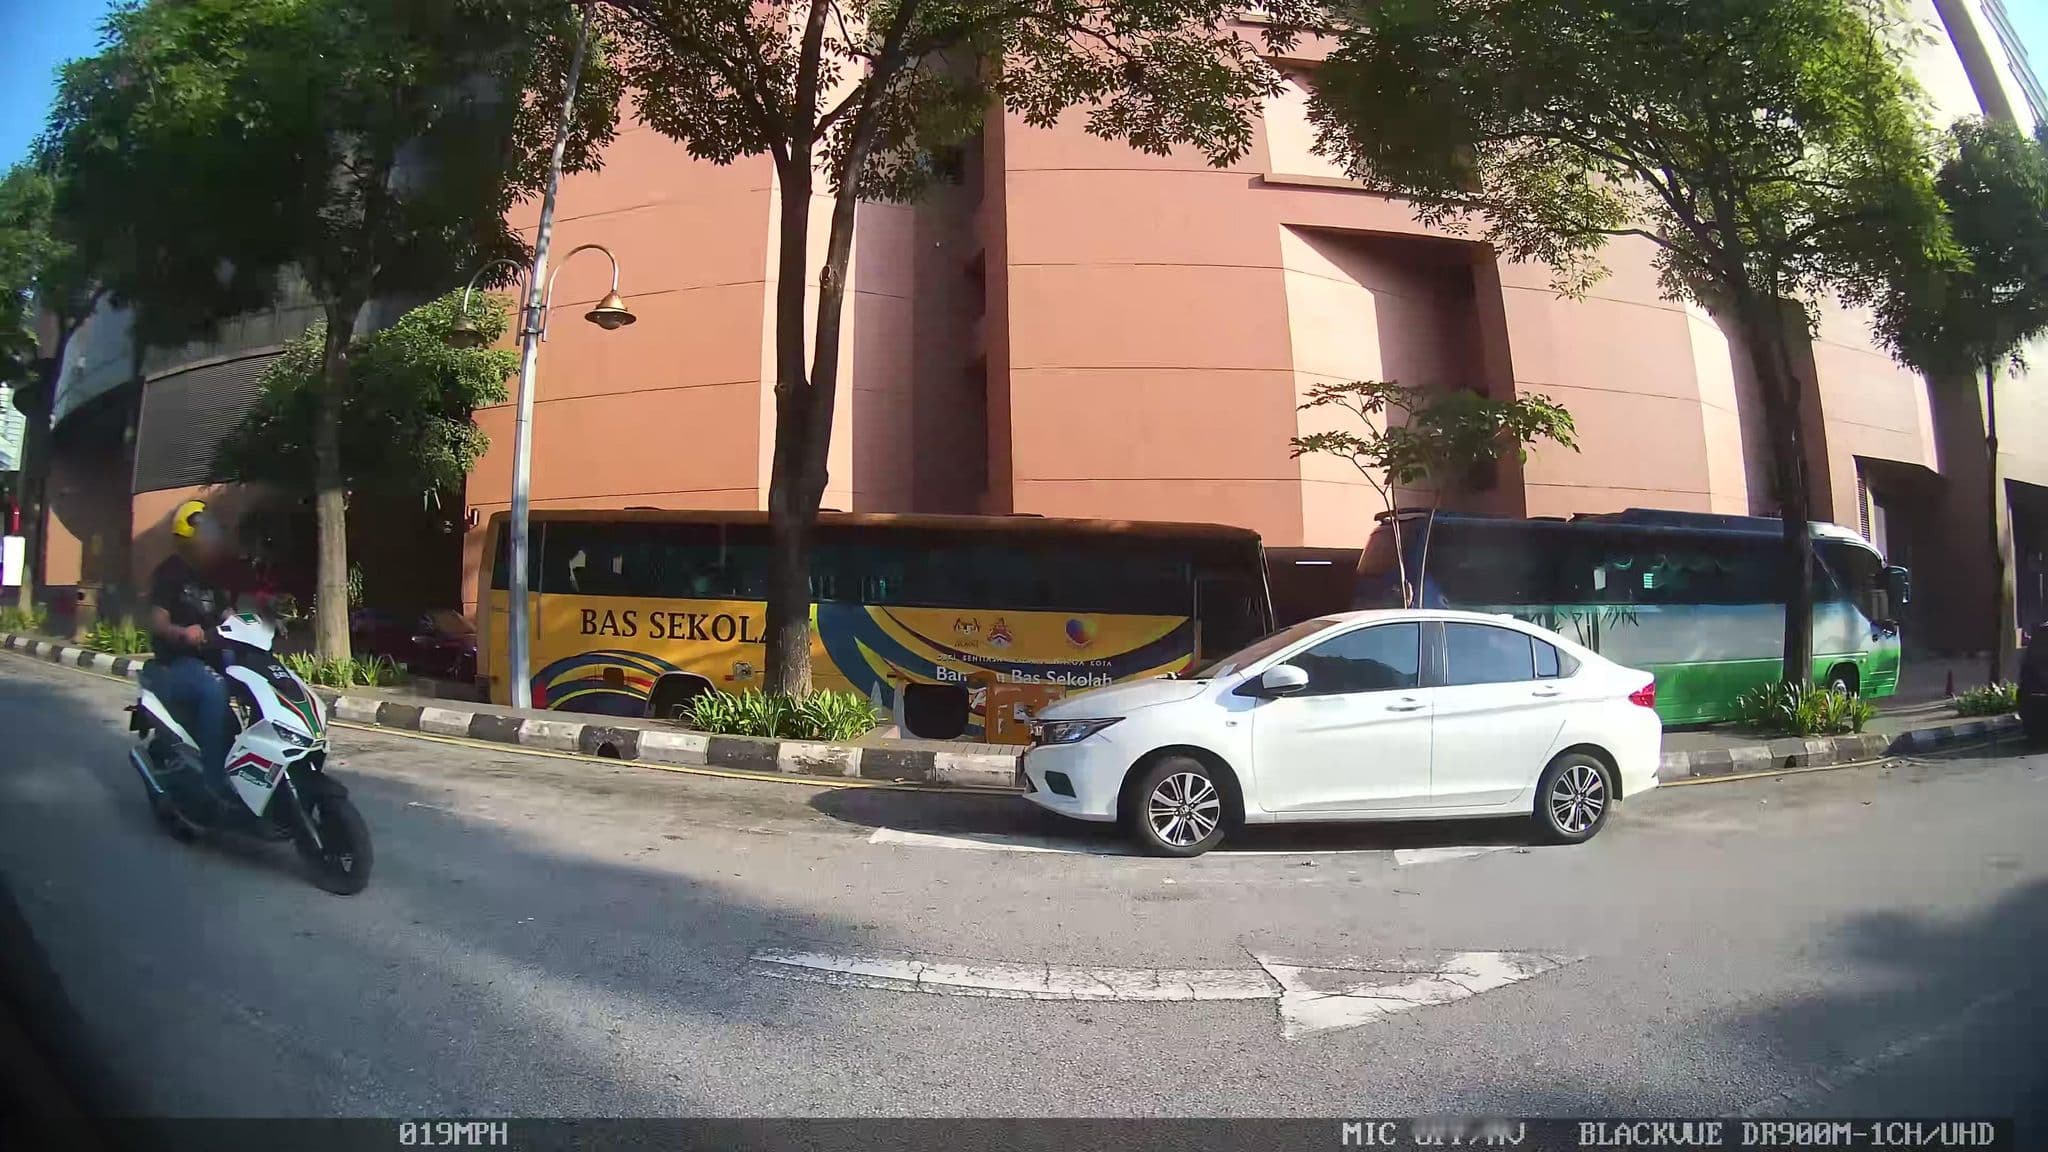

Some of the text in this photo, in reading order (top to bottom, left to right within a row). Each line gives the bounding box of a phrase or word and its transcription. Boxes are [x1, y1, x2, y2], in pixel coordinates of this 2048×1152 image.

[579, 608, 768, 644] BAS SEKOL
[1011, 669, 1041, 684] Bas
[1046, 671, 1113, 687] Sekolah
